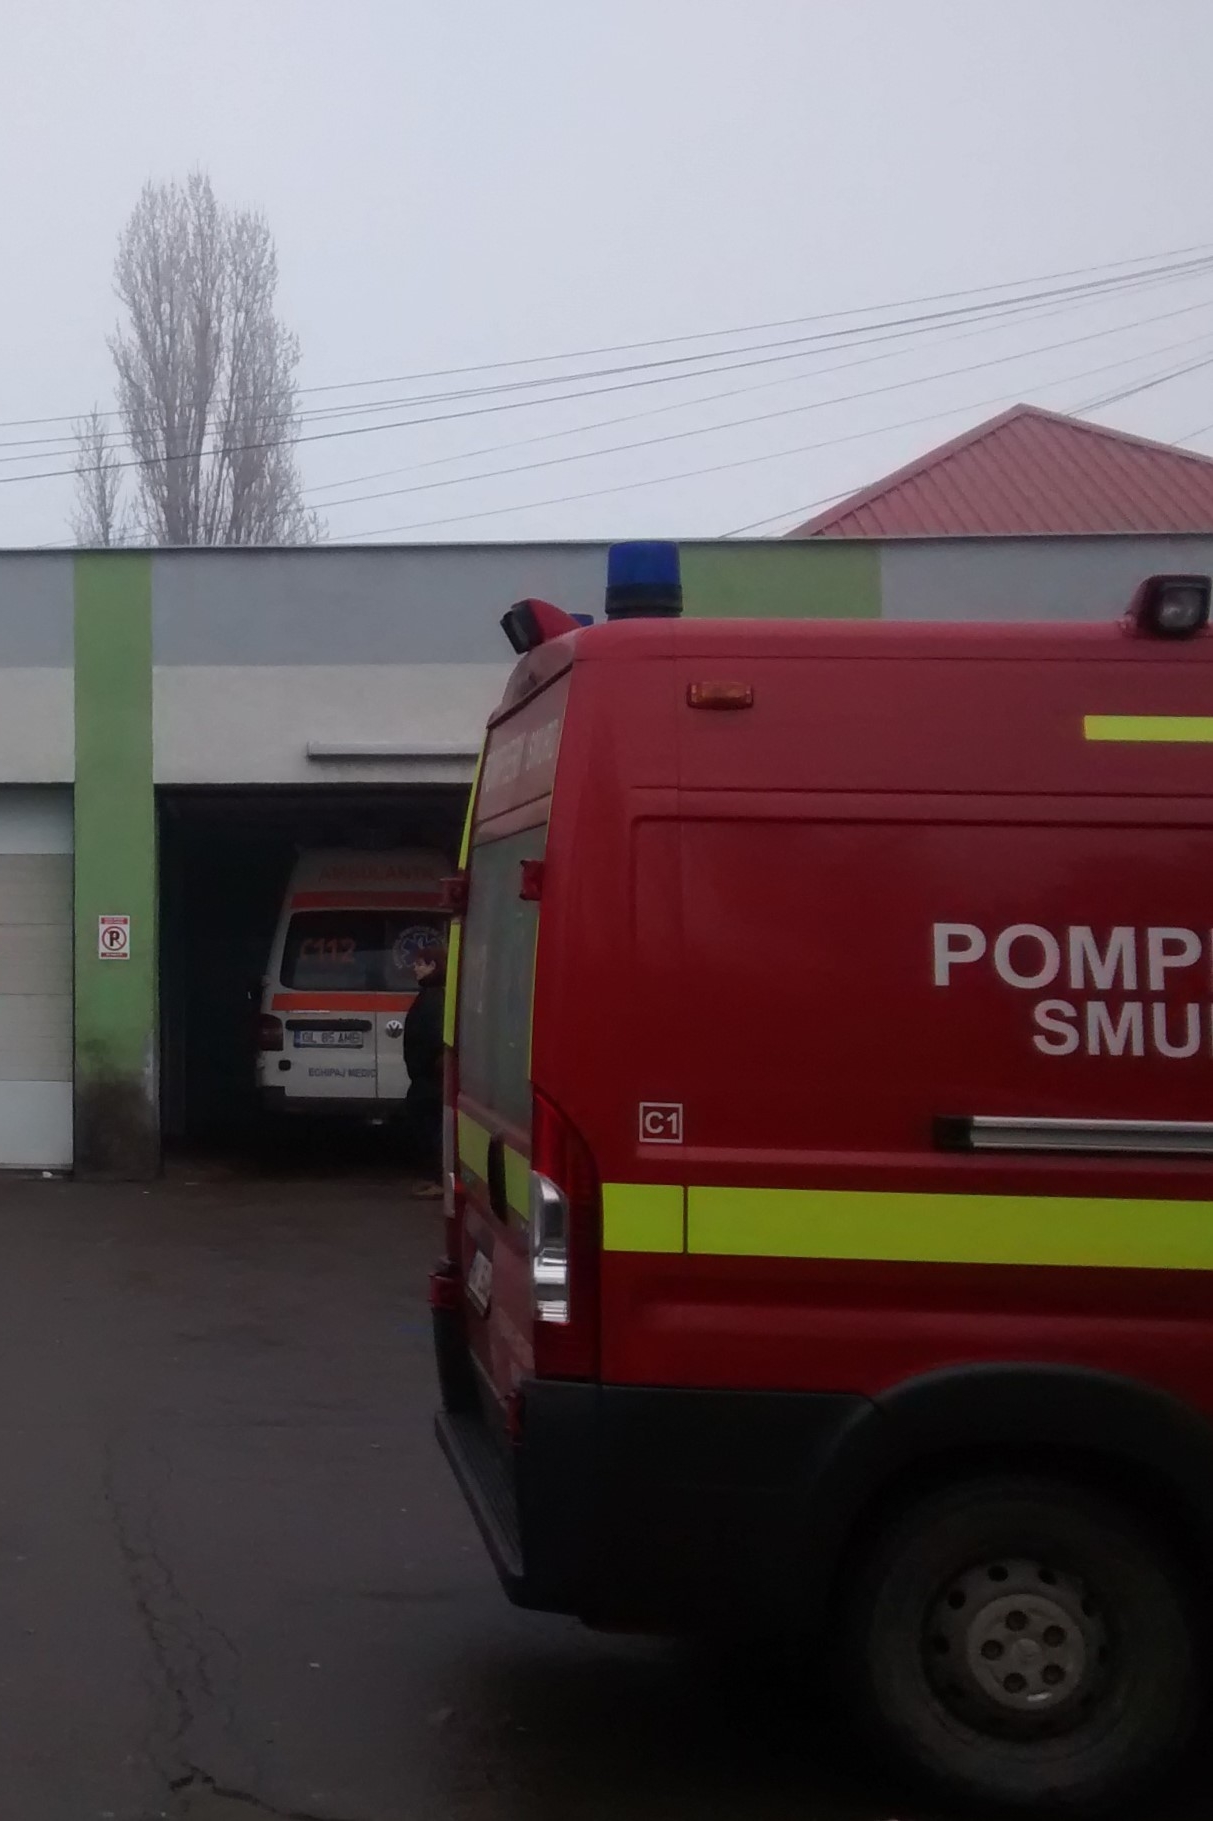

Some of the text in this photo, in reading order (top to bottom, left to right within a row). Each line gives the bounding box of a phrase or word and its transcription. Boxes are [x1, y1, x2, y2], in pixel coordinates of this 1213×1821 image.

[932, 922, 1213, 991] POMP
[1032, 998, 1213, 1059] SMU
[308, 1067, 345, 1078] ECHIPAJ
[645, 1111, 678, 1135] C1
